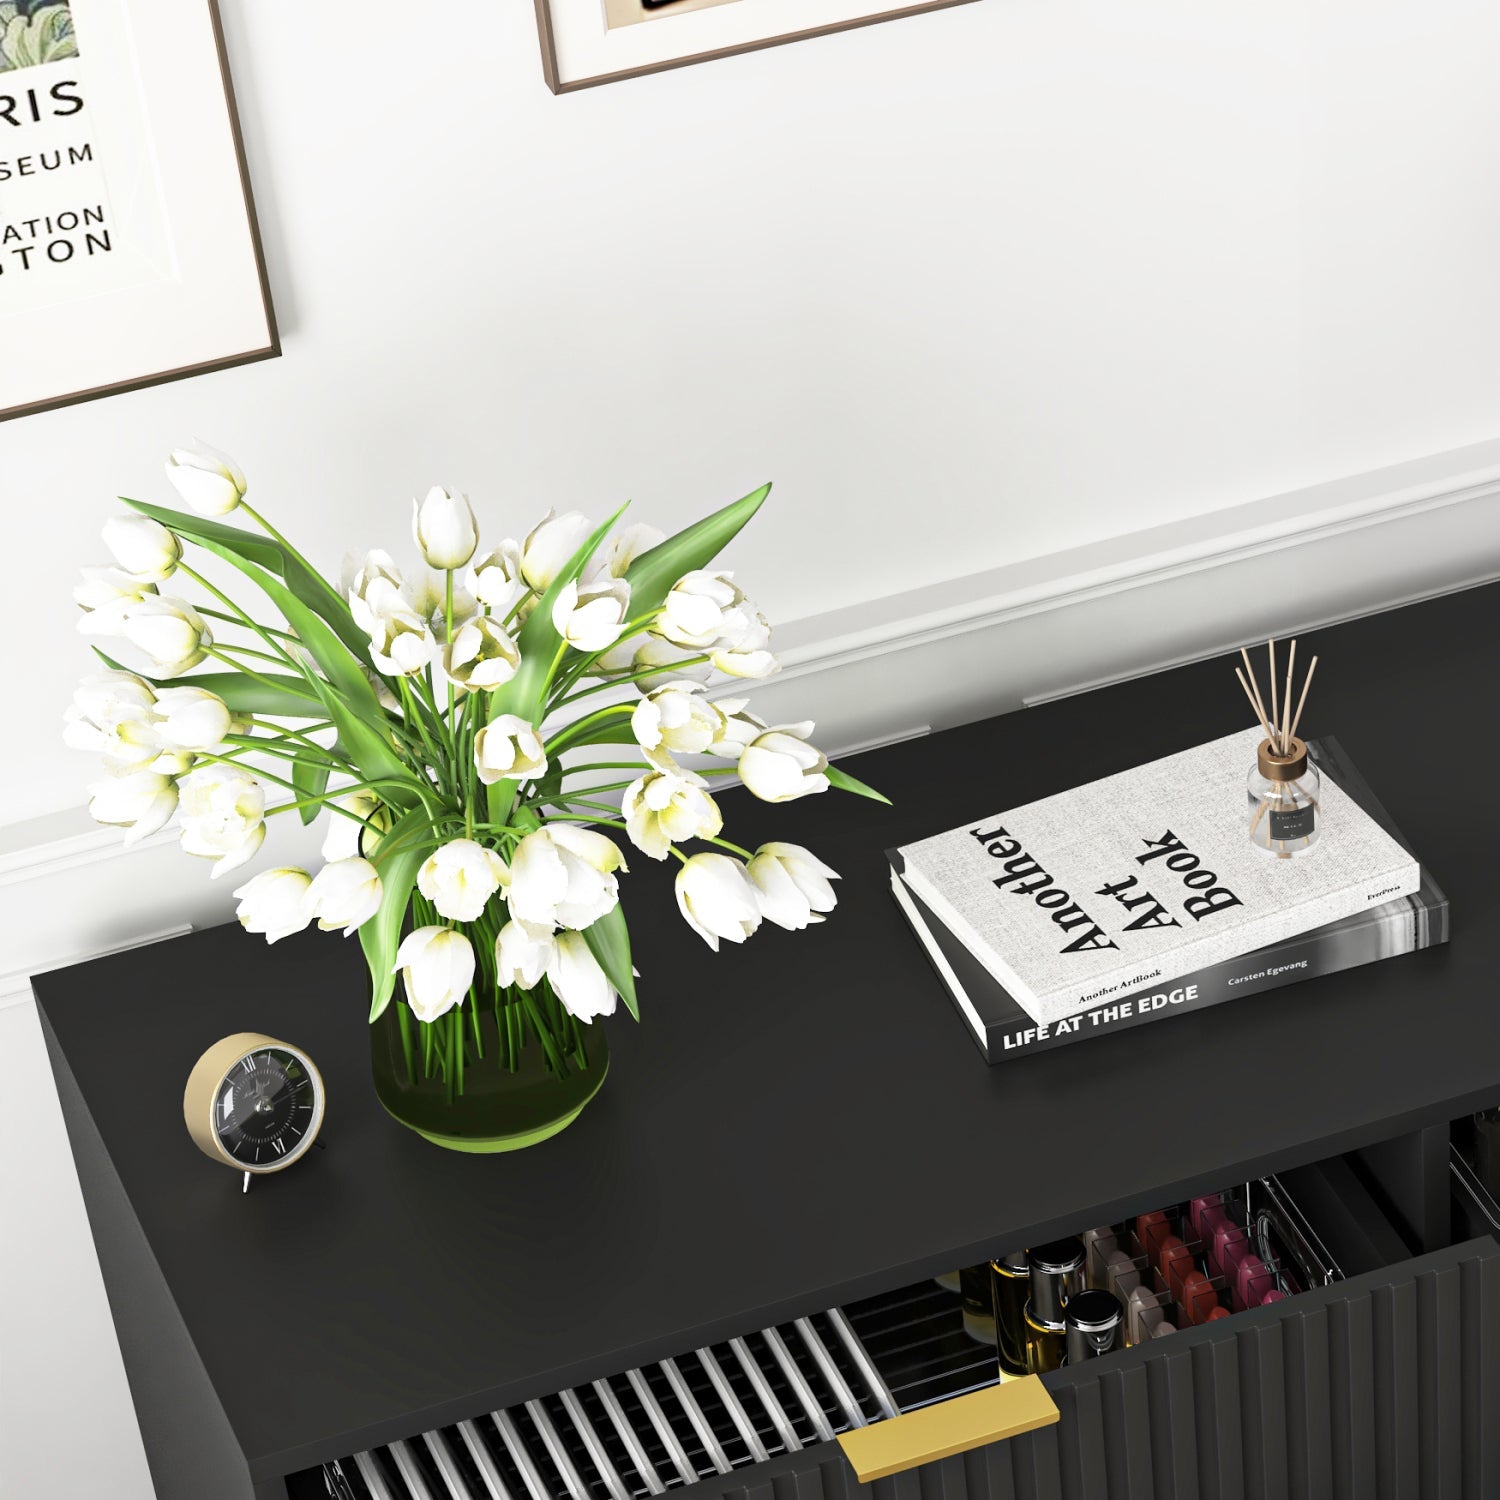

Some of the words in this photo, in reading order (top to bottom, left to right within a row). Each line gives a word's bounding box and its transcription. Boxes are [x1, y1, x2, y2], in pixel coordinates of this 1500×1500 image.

[0, 230, 111, 275] TON
[968, 825, 1121, 954] Another
[1093, 874, 1184, 932] Art
[1134, 828, 1245, 922] Book
[1078, 984, 1119, 1004] Another
[1119, 968, 1163, 989] ArtBook
[1227, 971, 1266, 986] Carsten
[1266, 960, 1308, 976] Egevang
[1003, 1023, 1050, 1050] LIFE
[1055, 1015, 1084, 1037] AT
[1088, 1002, 1134, 1026] THE
[1138, 984, 1199, 1014] EDGE
